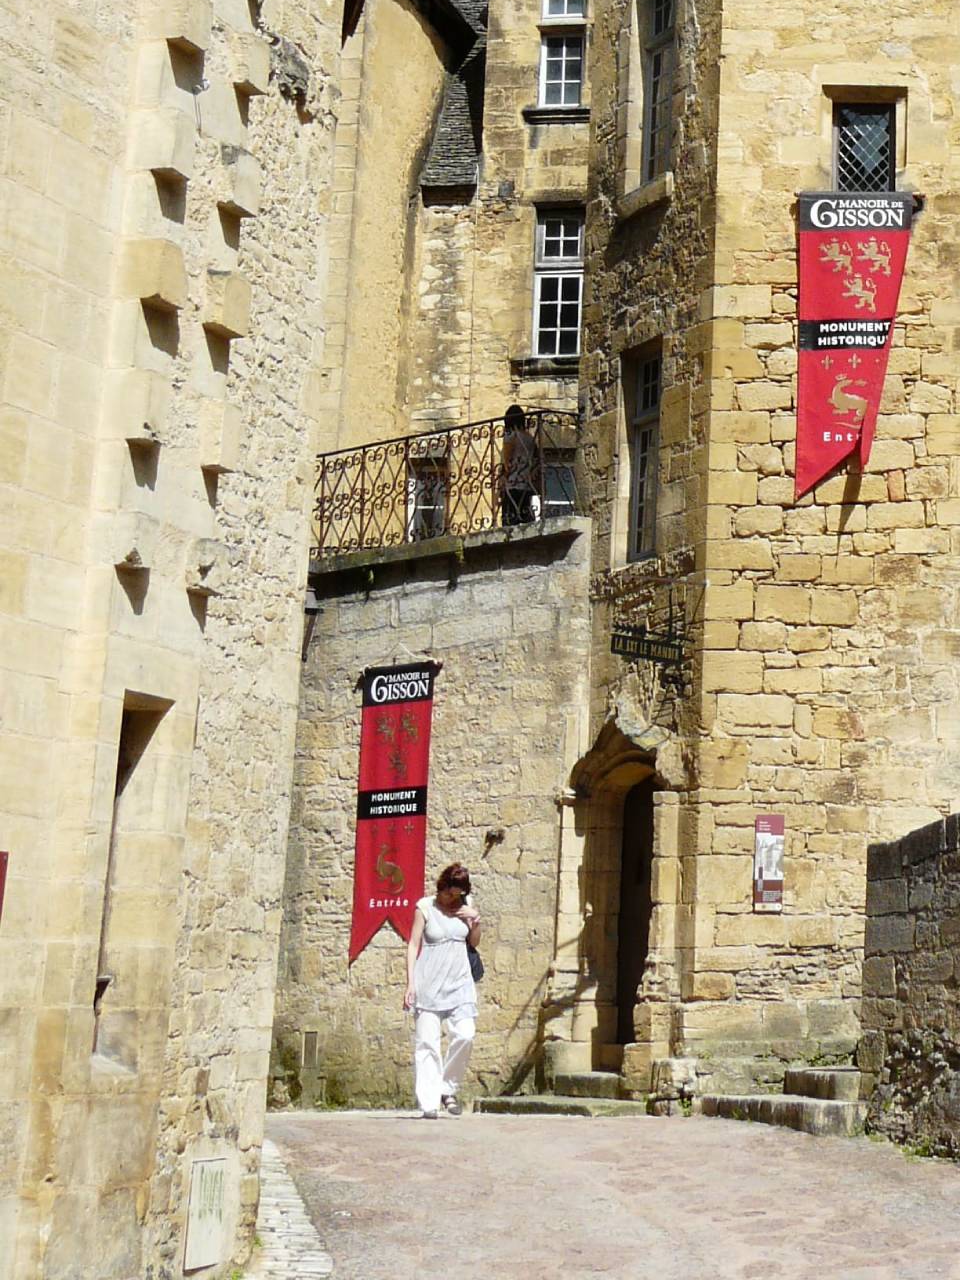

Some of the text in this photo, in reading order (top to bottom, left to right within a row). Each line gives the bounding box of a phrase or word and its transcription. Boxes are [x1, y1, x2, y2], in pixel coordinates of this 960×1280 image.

[839, 199, 904, 209] MANOIR DE
[810, 199, 904, 228] GISSON
[820, 322, 891, 333] MONUMENT
[817, 335, 889, 347] HISTORIQU
[388, 672, 420, 683] MANOIR
[370, 675, 430, 703] GISSON
[371, 790, 417, 802] MONUMENT
[370, 803, 418, 815] HISTORIQUE
[369, 897, 409, 908] Entrée
